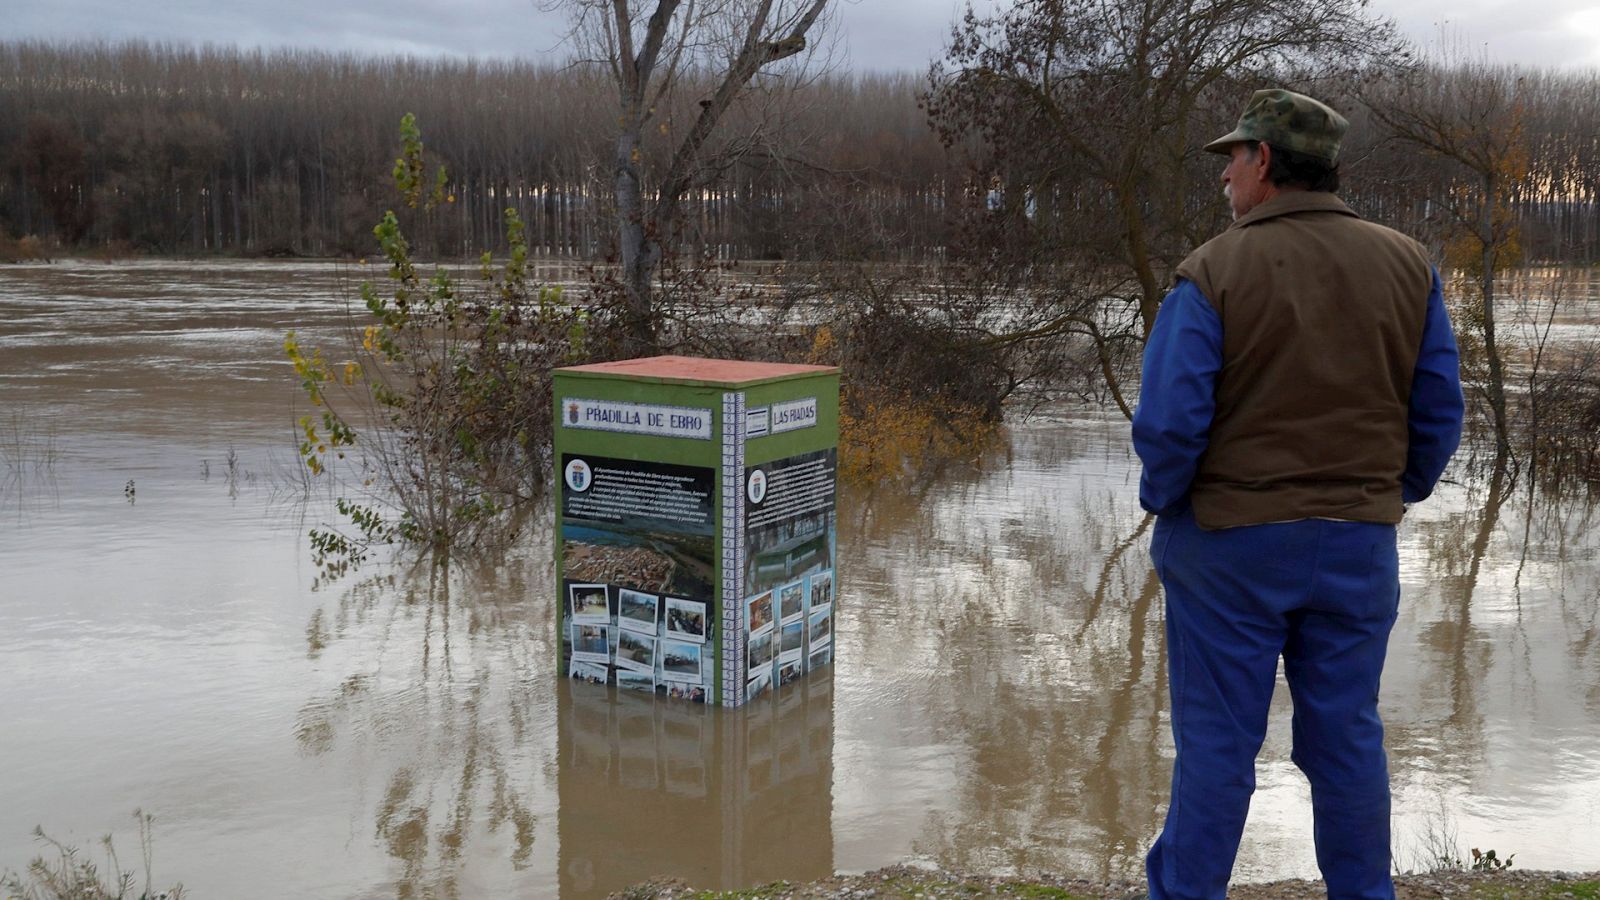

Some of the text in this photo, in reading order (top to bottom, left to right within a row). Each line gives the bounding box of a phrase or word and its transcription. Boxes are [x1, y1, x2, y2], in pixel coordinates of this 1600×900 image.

[586, 407, 702, 430] PRADILLA DE EBRO
[774, 412, 788, 425] LAS
[790, 406, 814, 422] RIADAS
